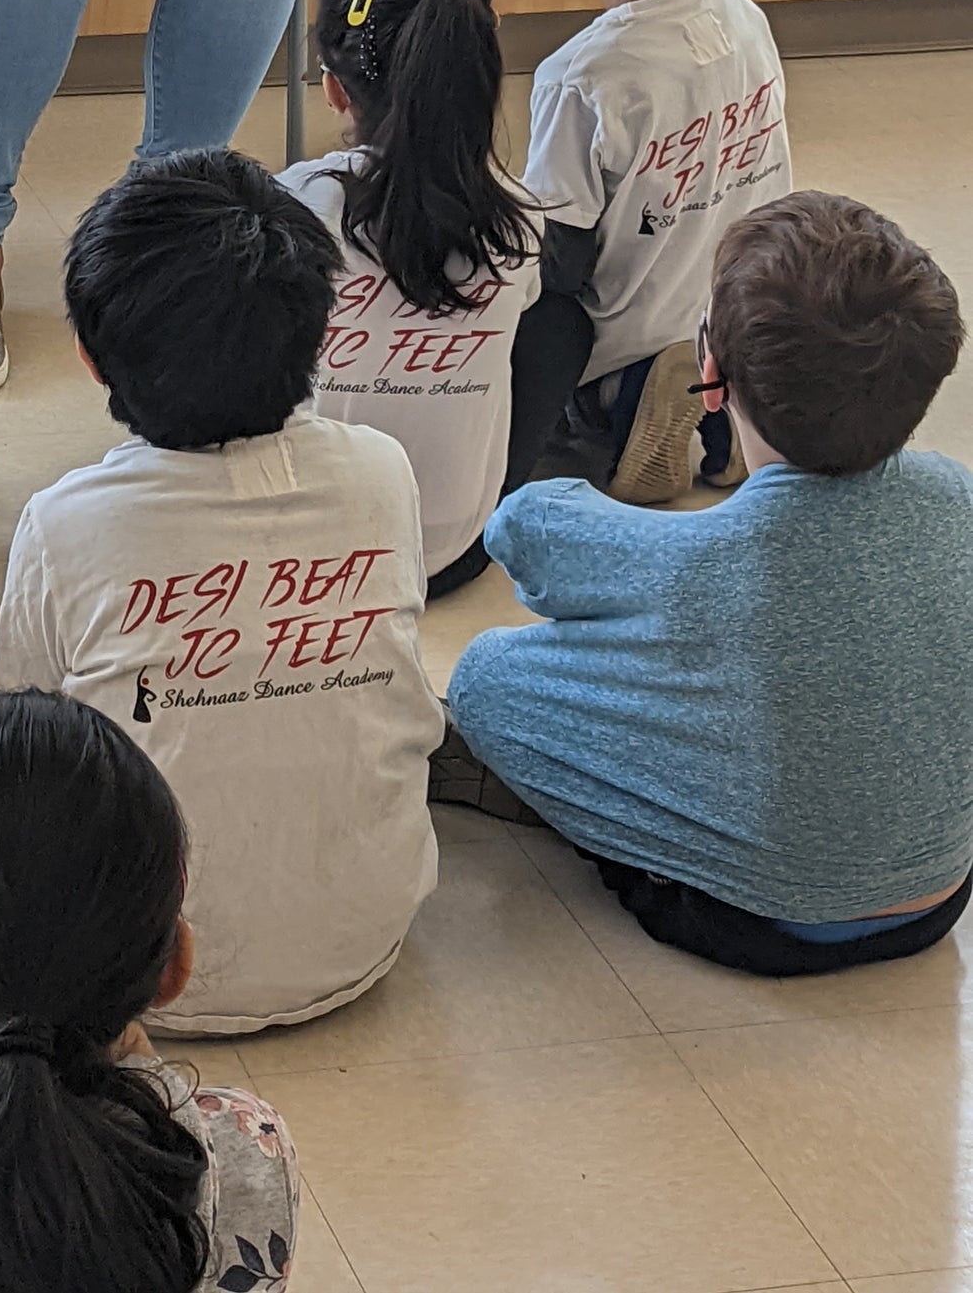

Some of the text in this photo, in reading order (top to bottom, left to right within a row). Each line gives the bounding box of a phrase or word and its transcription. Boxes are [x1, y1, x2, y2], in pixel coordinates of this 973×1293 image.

[719, 76, 777, 143] BAT
[715, 119, 783, 183] FET
[378, 327, 505, 375] FEET
[311, 374, 491, 397] hehnaaz Dance Academy
[119, 549, 396, 635] DESI BEAT
[164, 608, 400, 680] JC FEET
[159, 667, 395, 709] Shehnaaz Dance Academy
